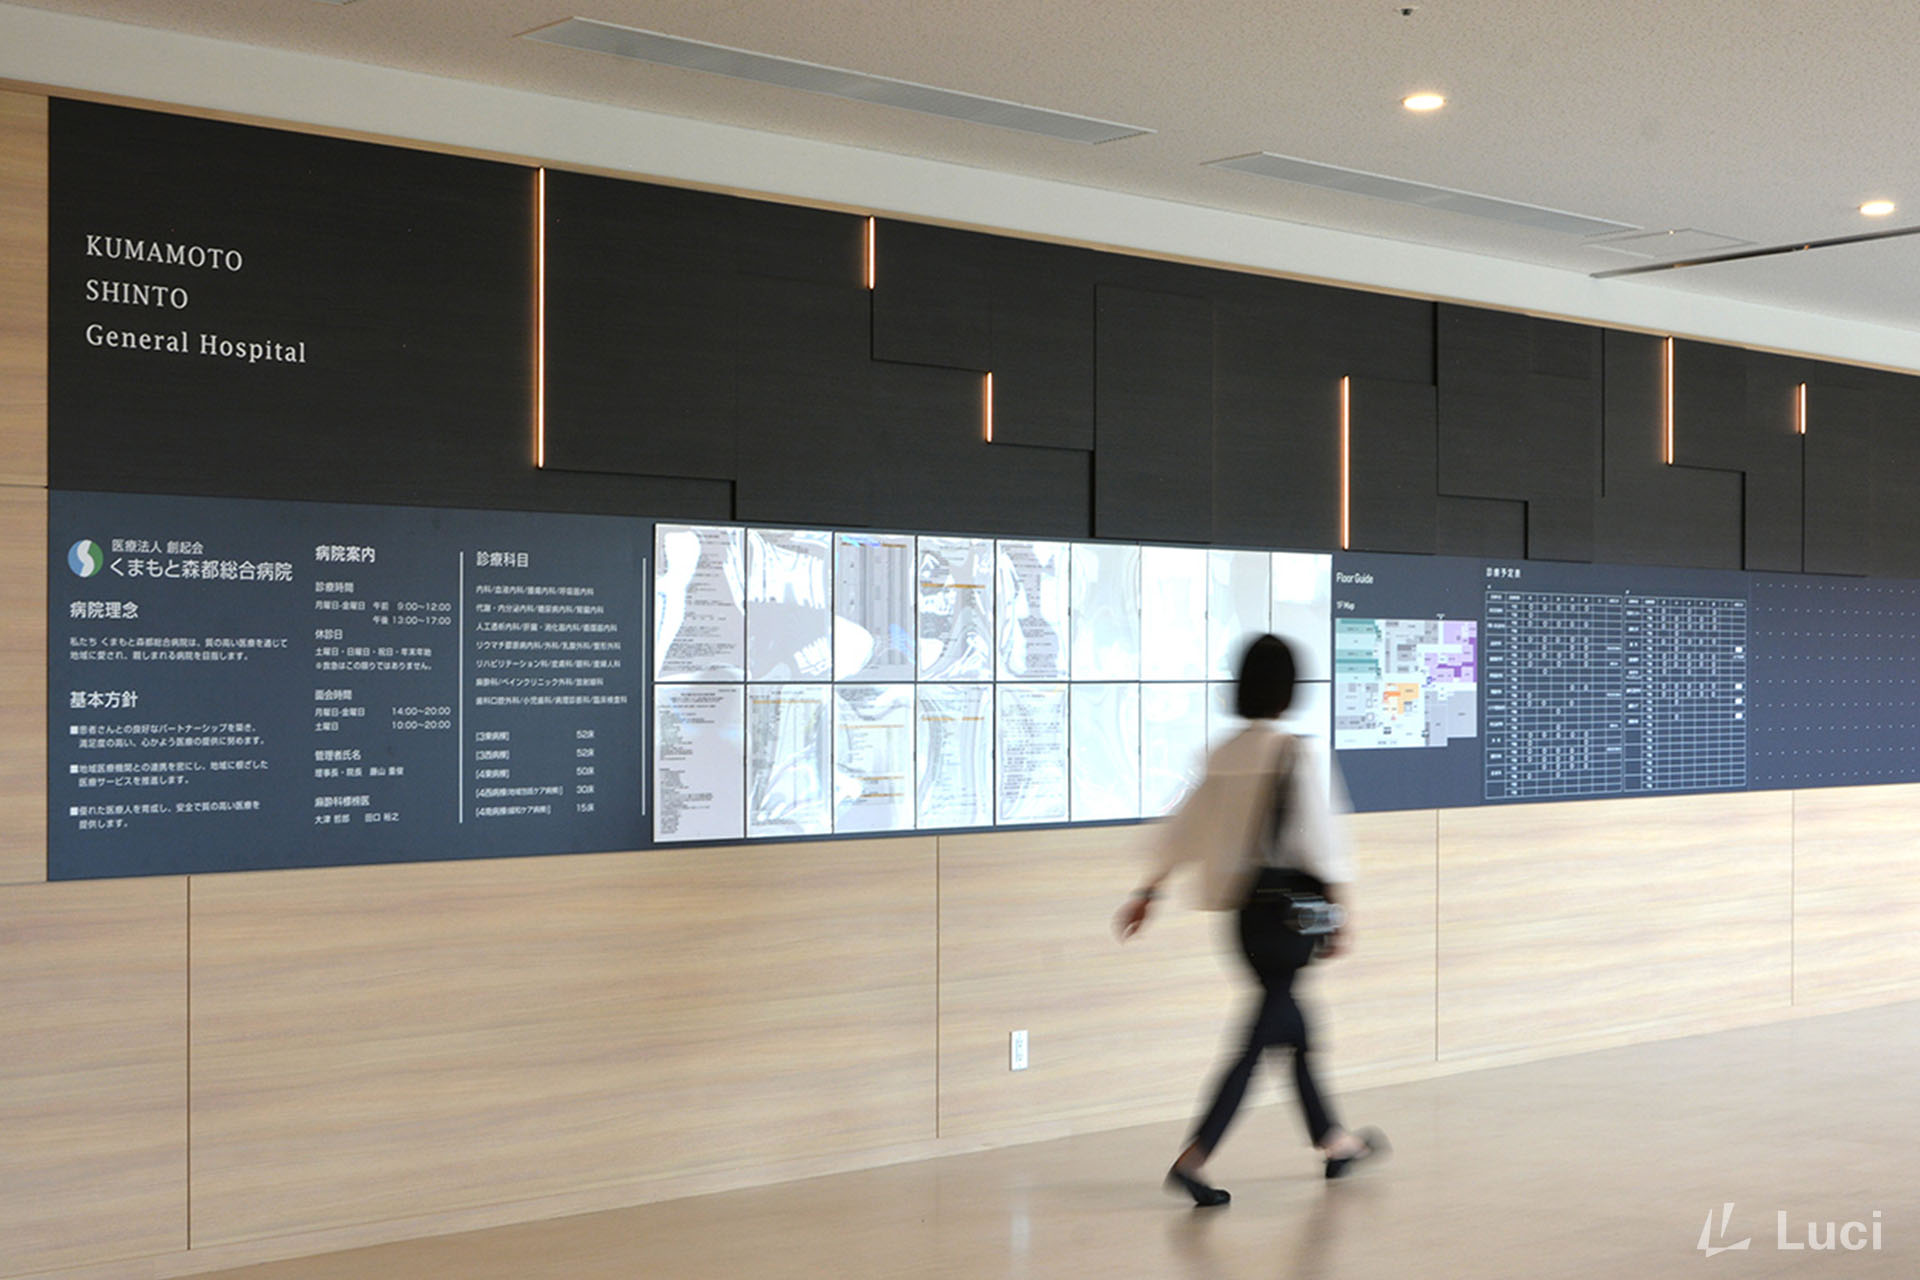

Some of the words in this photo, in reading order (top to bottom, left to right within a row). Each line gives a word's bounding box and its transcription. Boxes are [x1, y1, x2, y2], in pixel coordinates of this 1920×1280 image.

[87, 235, 242, 271] KUMAMOTO
[86, 279, 188, 309] SHINTO
[86, 324, 188, 352] General
[200, 334, 305, 363] Hospital
[315, 545, 375, 563] 病院案内
[477, 551, 528, 567] 診療科目
[110, 558, 293, 581] くまもと森都総合病院
[70, 601, 138, 619] 病院理念
[70, 691, 138, 708] 基本方針
